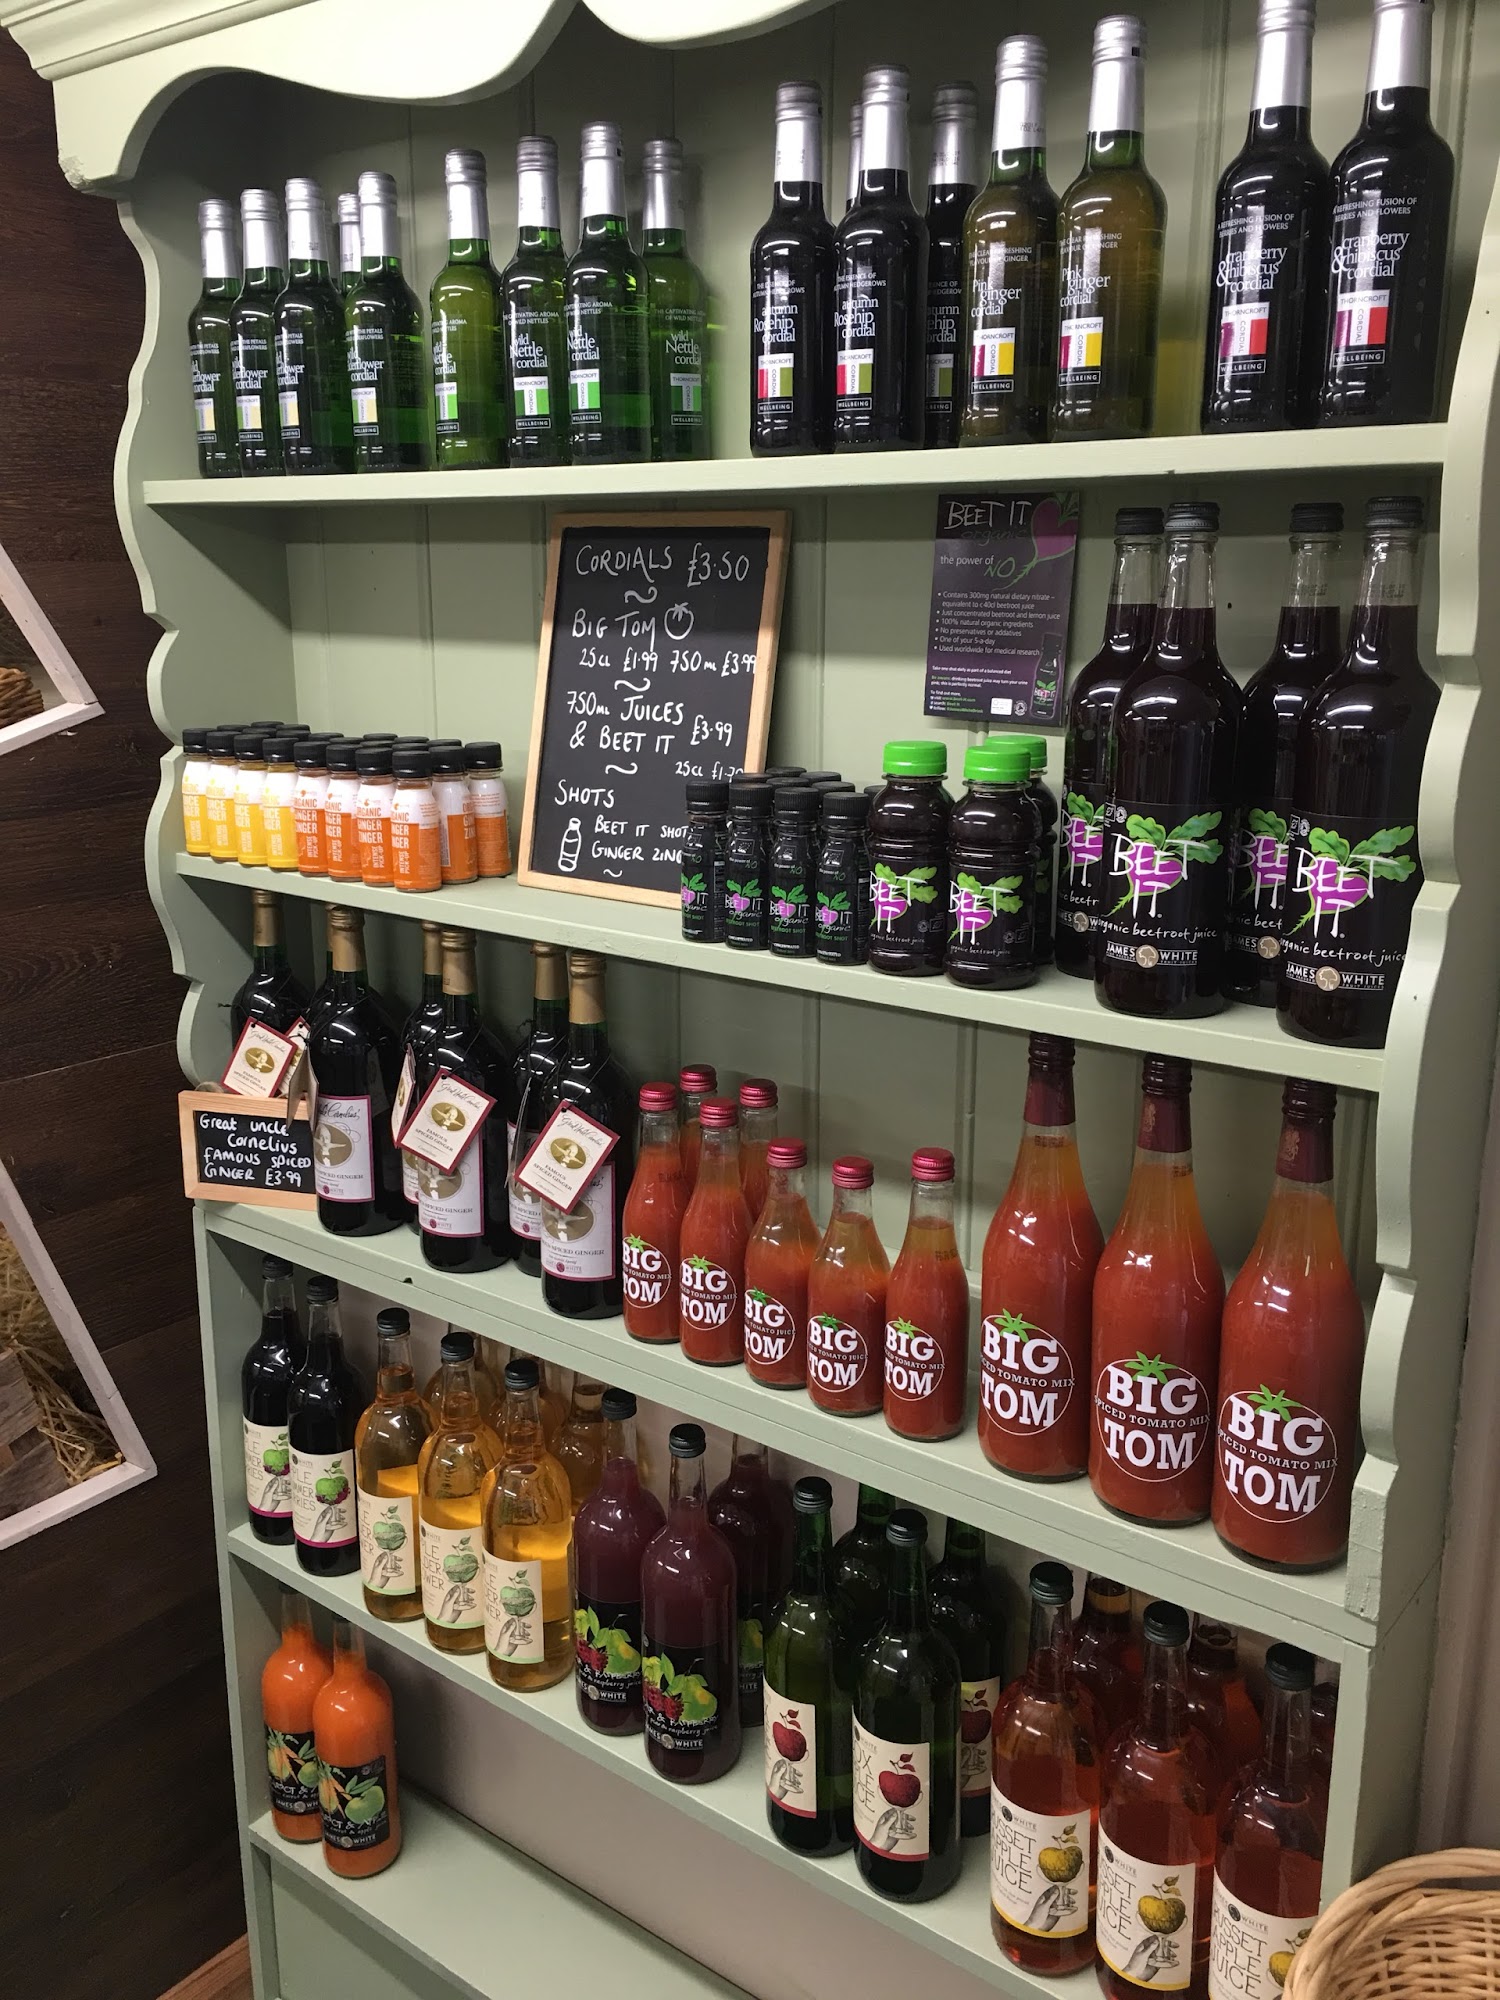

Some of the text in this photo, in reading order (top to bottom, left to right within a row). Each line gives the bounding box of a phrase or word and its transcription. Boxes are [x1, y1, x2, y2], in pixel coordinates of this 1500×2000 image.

[1376, 197, 1417, 206] FUSION OF
[1376, 206, 1411, 216] FLOWERS
[1341, 231, 1410, 252] cranberry
[1346, 246, 1401, 265] hibiscus
[1062, 265, 1082, 281] Pink
[1347, 260, 1395, 280] cordial
[972, 277, 993, 292] Pink
[1068, 273, 1111, 292] ginger
[1230, 274, 1274, 293] cordial
[842, 298, 879, 310] autumn
[980, 287, 1022, 305] ginger
[1060, 292, 1092, 308] cordial
[1340, 294, 1387, 305] THORNCROFT
[834, 310, 874, 328] Rosehip
[971, 302, 1004, 318] cordial
[754, 315, 794, 333] Rosehip
[841, 321, 876, 339] cordial
[1355, 308, 1364, 343] CORDIAL
[567, 335, 596, 351] Nettle
[762, 326, 796, 344] cordial
[509, 341, 543, 358] Nettle
[571, 347, 600, 362] cordial
[665, 339, 700, 354] Nettle
[516, 354, 548, 369] cordial
[1336, 353, 1381, 362] WELLBEING
[350, 367, 378, 382] cordial
[944, 500, 1032, 530] BEET IT
[575, 545, 673, 583] CORDIALS
[940, 555, 994, 567] the power of
[984, 556, 1016, 578] NO
[942, 591, 968, 599] Contains
[970, 592, 989, 600] 300mg
[1011, 593, 1030, 601] dietary
[953, 610, 990, 618] concentrated
[991, 611, 1015, 619] beetroot
[1047, 613, 1061, 621] juice
[980, 620, 1001, 628] organic
[1002, 621, 1034, 629] ingredients
[572, 608, 656, 652] BIG TOM
[950, 628, 986, 636] preservatives
[960, 637, 973, 645] your
[974, 637, 996, 646] 5-a-day
[623, 647, 659, 673] £1.99
[1017, 648, 1040, 656] research
[620, 695, 684, 726] JUICES
[569, 714, 733, 755] & BEET IT £3.99
[555, 779, 616, 809] SHOTS
[594, 814, 628, 836] BEET
[635, 824, 650, 837] IT
[591, 840, 645, 862] GINGER
[1109, 832, 1211, 880] BEET
[1292, 846, 1400, 900] BEET
[869, 870, 928, 907] BEET
[949, 880, 1014, 918] BEET
[1132, 922, 1190, 940] beetroot
[1188, 927, 1217, 943] juice
[1107, 943, 1198, 961] JAMES WHITE
[1313, 942, 1376, 963] beetroot
[1286, 962, 1316, 979] JAMES
[1342, 973, 1385, 986] WHITE
[199, 1113, 289, 1137] Great uncle
[227, 1133, 298, 1155] Cornelius
[271, 1154, 311, 1169] SPICED
[265, 1168, 301, 1187] £3.99
[622, 1241, 662, 1272] BIG
[628, 1269, 655, 1280] TOMATO
[681, 1262, 728, 1293] BIG
[691, 1290, 721, 1301] TOMATO
[681, 1293, 728, 1325] TOM
[744, 1296, 785, 1327] BIG
[750, 1321, 775, 1334] TOMATO
[809, 1319, 858, 1353] BIG
[744, 1325, 785, 1360] TOM
[886, 1320, 935, 1361] BIG
[983, 1320, 1060, 1375] BIG
[817, 1349, 848, 1361] TOMATO
[895, 1355, 927, 1370] TOMATO
[808, 1352, 858, 1387] TOM
[885, 1356, 934, 1396] TOM
[997, 1368, 1076, 1388] TOMATO MIX
[1106, 1365, 1198, 1416] BIG
[981, 1374, 1059, 1428] TOM
[1129, 1413, 1186, 1429] TOMATO
[1189, 1413, 1212, 1427] MIX
[1227, 1396, 1325, 1457] BIG
[1104, 1417, 1196, 1471] TOM
[1249, 1449, 1310, 1471] TOMATO
[1313, 1456, 1338, 1470] MIX
[1224, 1449, 1321, 1514] TOM
[600, 1691, 627, 1700] WHITE
[1212, 1924, 1262, 1978] APPLE
[1210, 1944, 1262, 2000] JUICE
